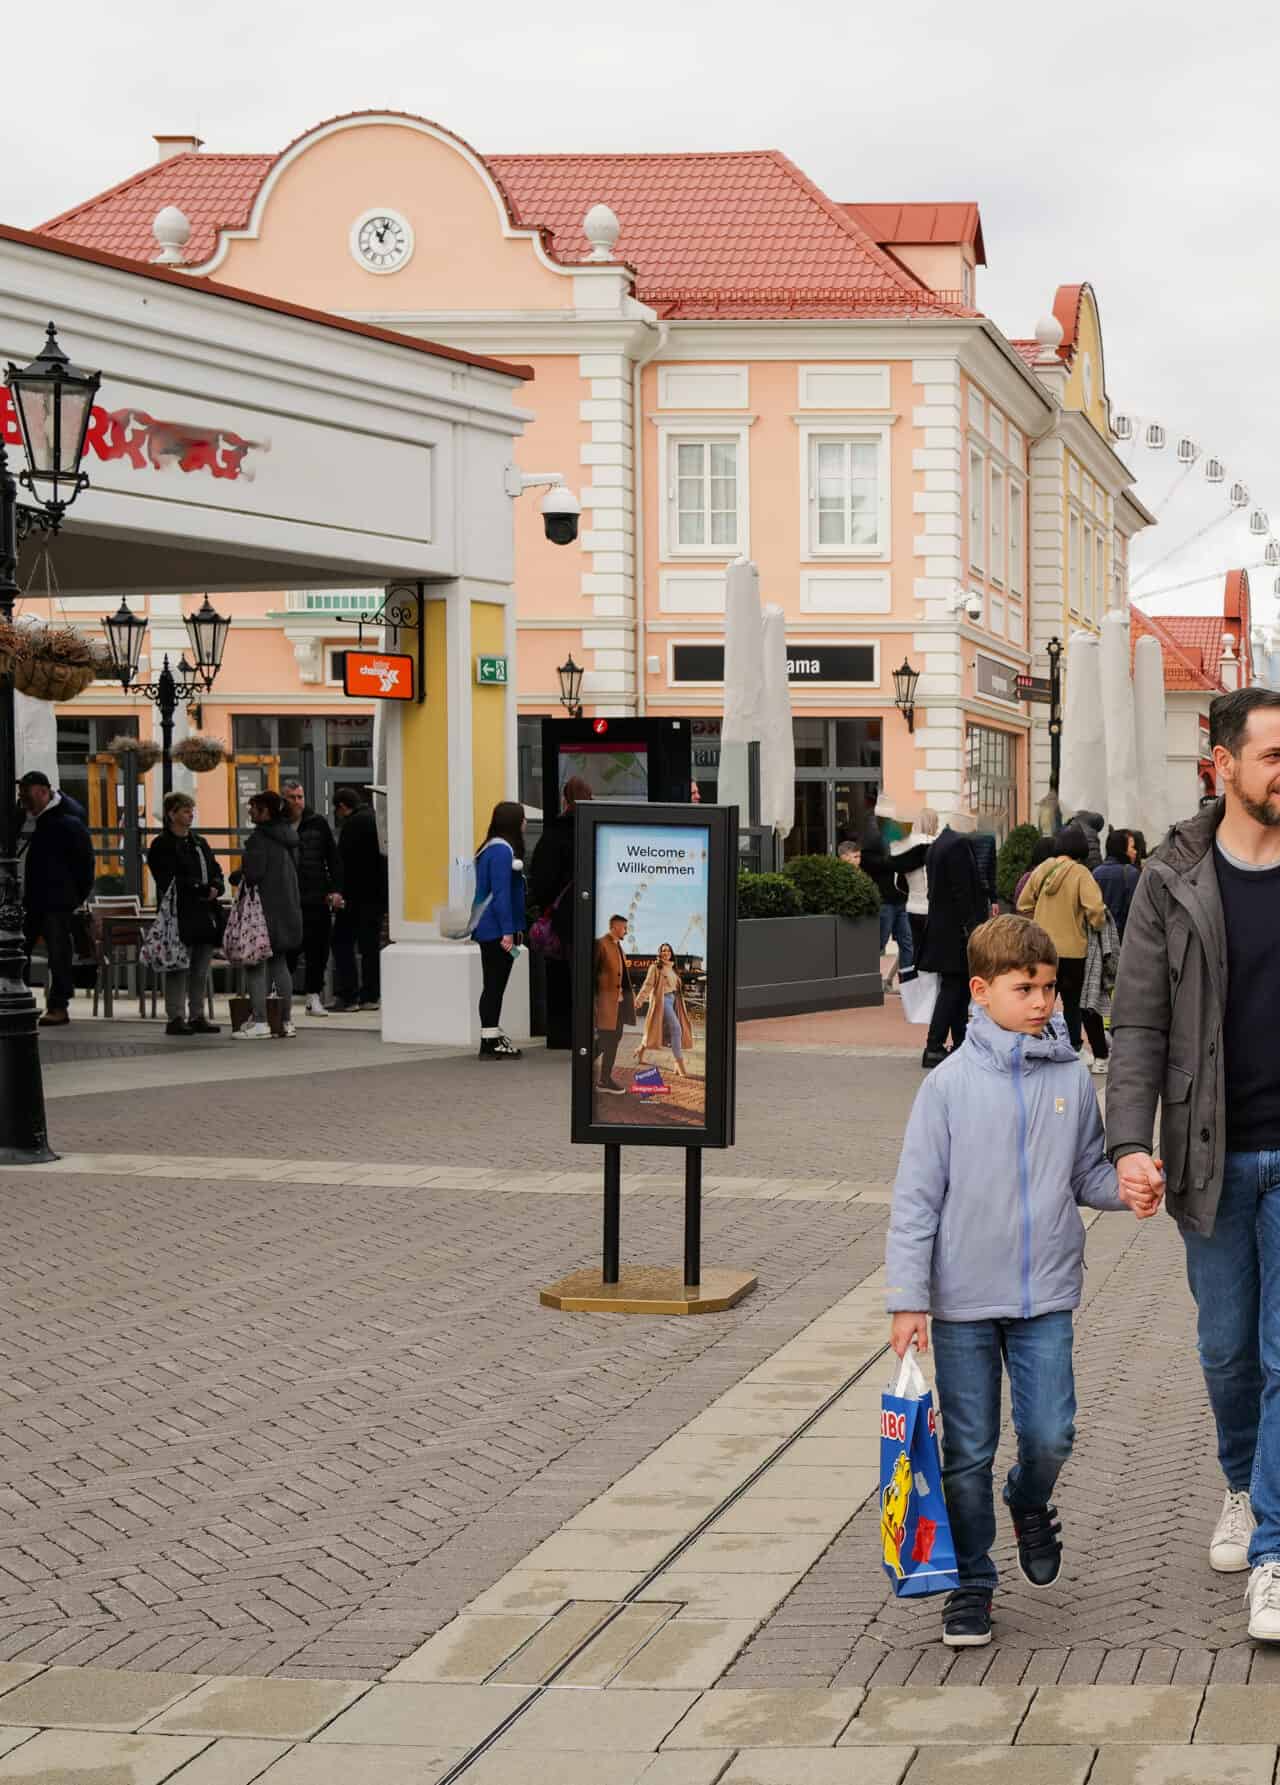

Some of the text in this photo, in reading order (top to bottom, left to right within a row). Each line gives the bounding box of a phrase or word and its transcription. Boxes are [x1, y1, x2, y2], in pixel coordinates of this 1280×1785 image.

[785, 658, 820, 674] ama
[626, 845, 686, 858] Welcome
[616, 861, 695, 875] Willkommen
